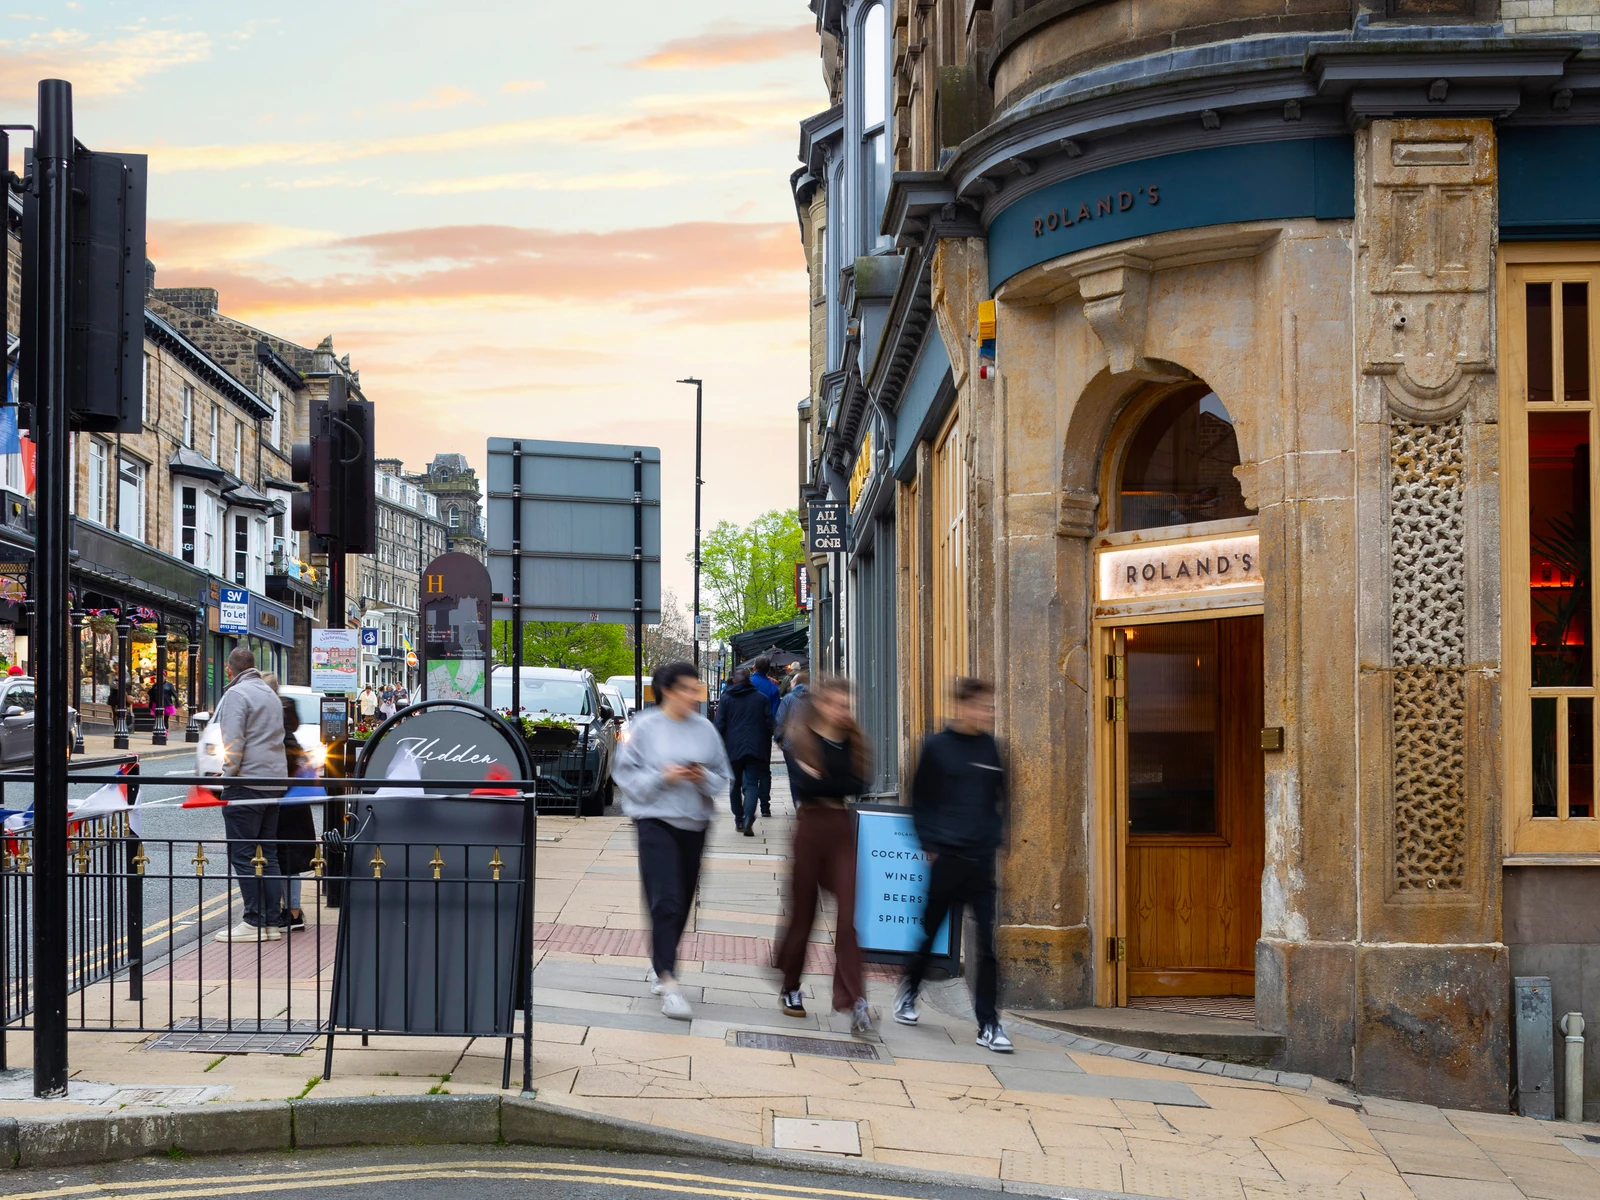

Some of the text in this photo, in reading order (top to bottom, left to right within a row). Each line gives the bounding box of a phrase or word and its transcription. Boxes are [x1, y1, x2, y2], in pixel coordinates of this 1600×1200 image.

[1033, 185, 1160, 237] ROLAND'S
[816, 511, 837, 520] ALL
[816, 524, 839, 534] BAR
[815, 538, 841, 548] ONE
[1127, 553, 1253, 583] ROLAND'S
[427, 574, 444, 593] H
[227, 591, 242, 602] SW
[222, 609, 246, 619] To Let
[396, 737, 498, 764] Hidden
[871, 850, 931, 862] COCKTAIL
[884, 872, 923, 882] WINES
[883, 893, 923, 904] BEERS
[879, 914, 925, 925] SPIRITS
